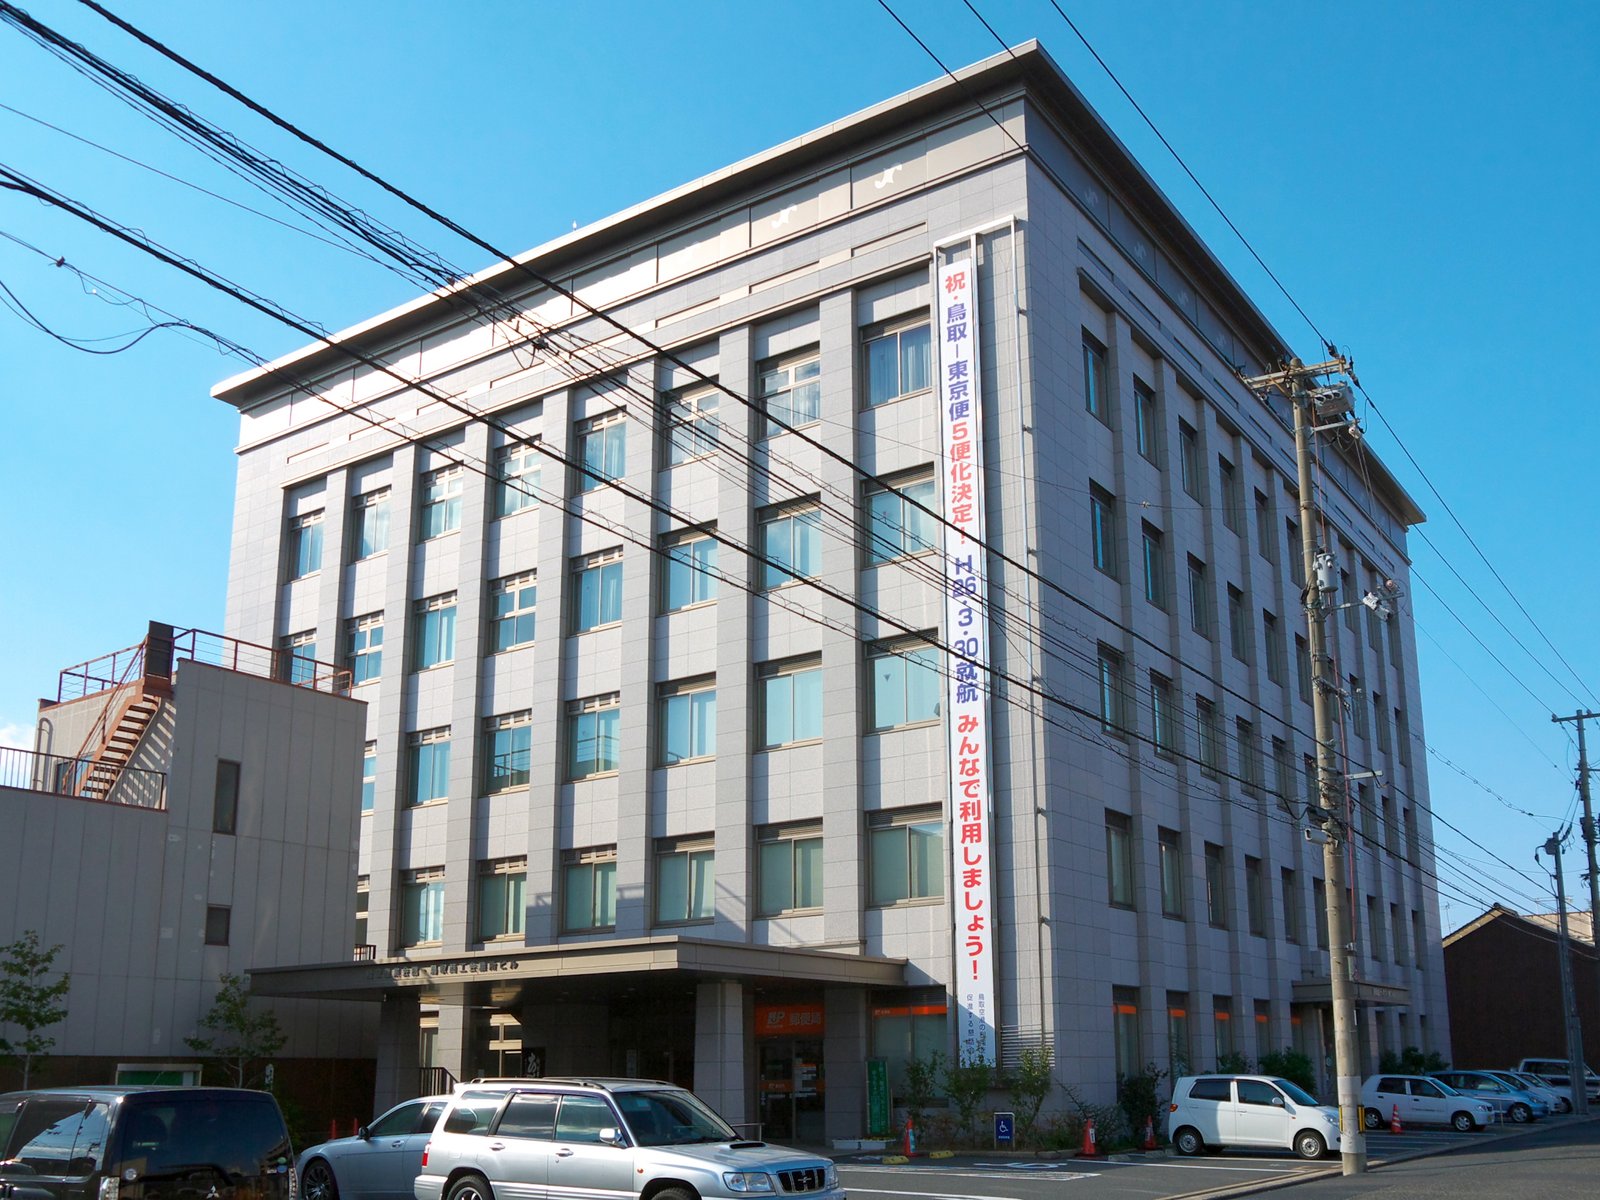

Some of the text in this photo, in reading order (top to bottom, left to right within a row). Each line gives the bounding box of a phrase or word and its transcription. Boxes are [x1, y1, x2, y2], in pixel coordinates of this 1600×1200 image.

[956, 714, 984, 980] みんなで利用しましょう!
